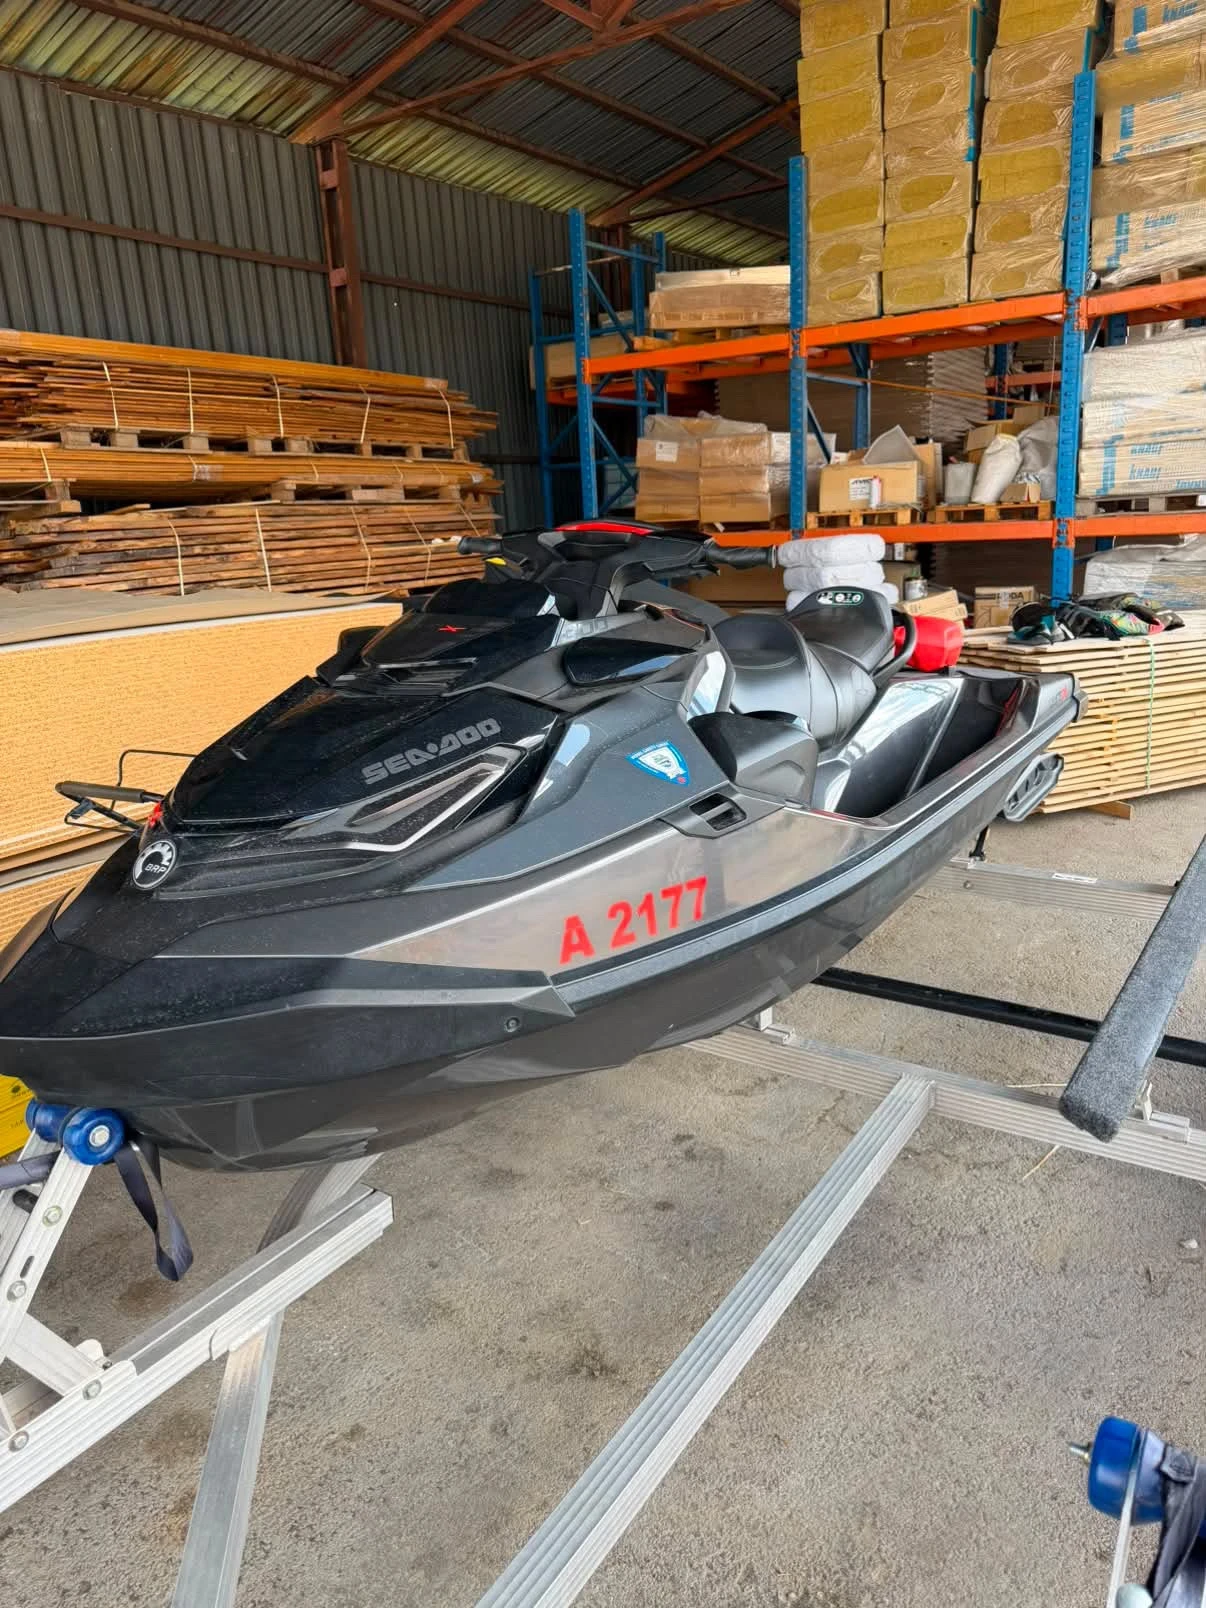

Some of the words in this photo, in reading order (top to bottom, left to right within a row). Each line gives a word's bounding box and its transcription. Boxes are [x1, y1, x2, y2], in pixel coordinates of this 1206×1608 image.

[145, 863, 167, 873] BRP
[559, 915, 595, 965] A
[607, 876, 708, 950] 2177
